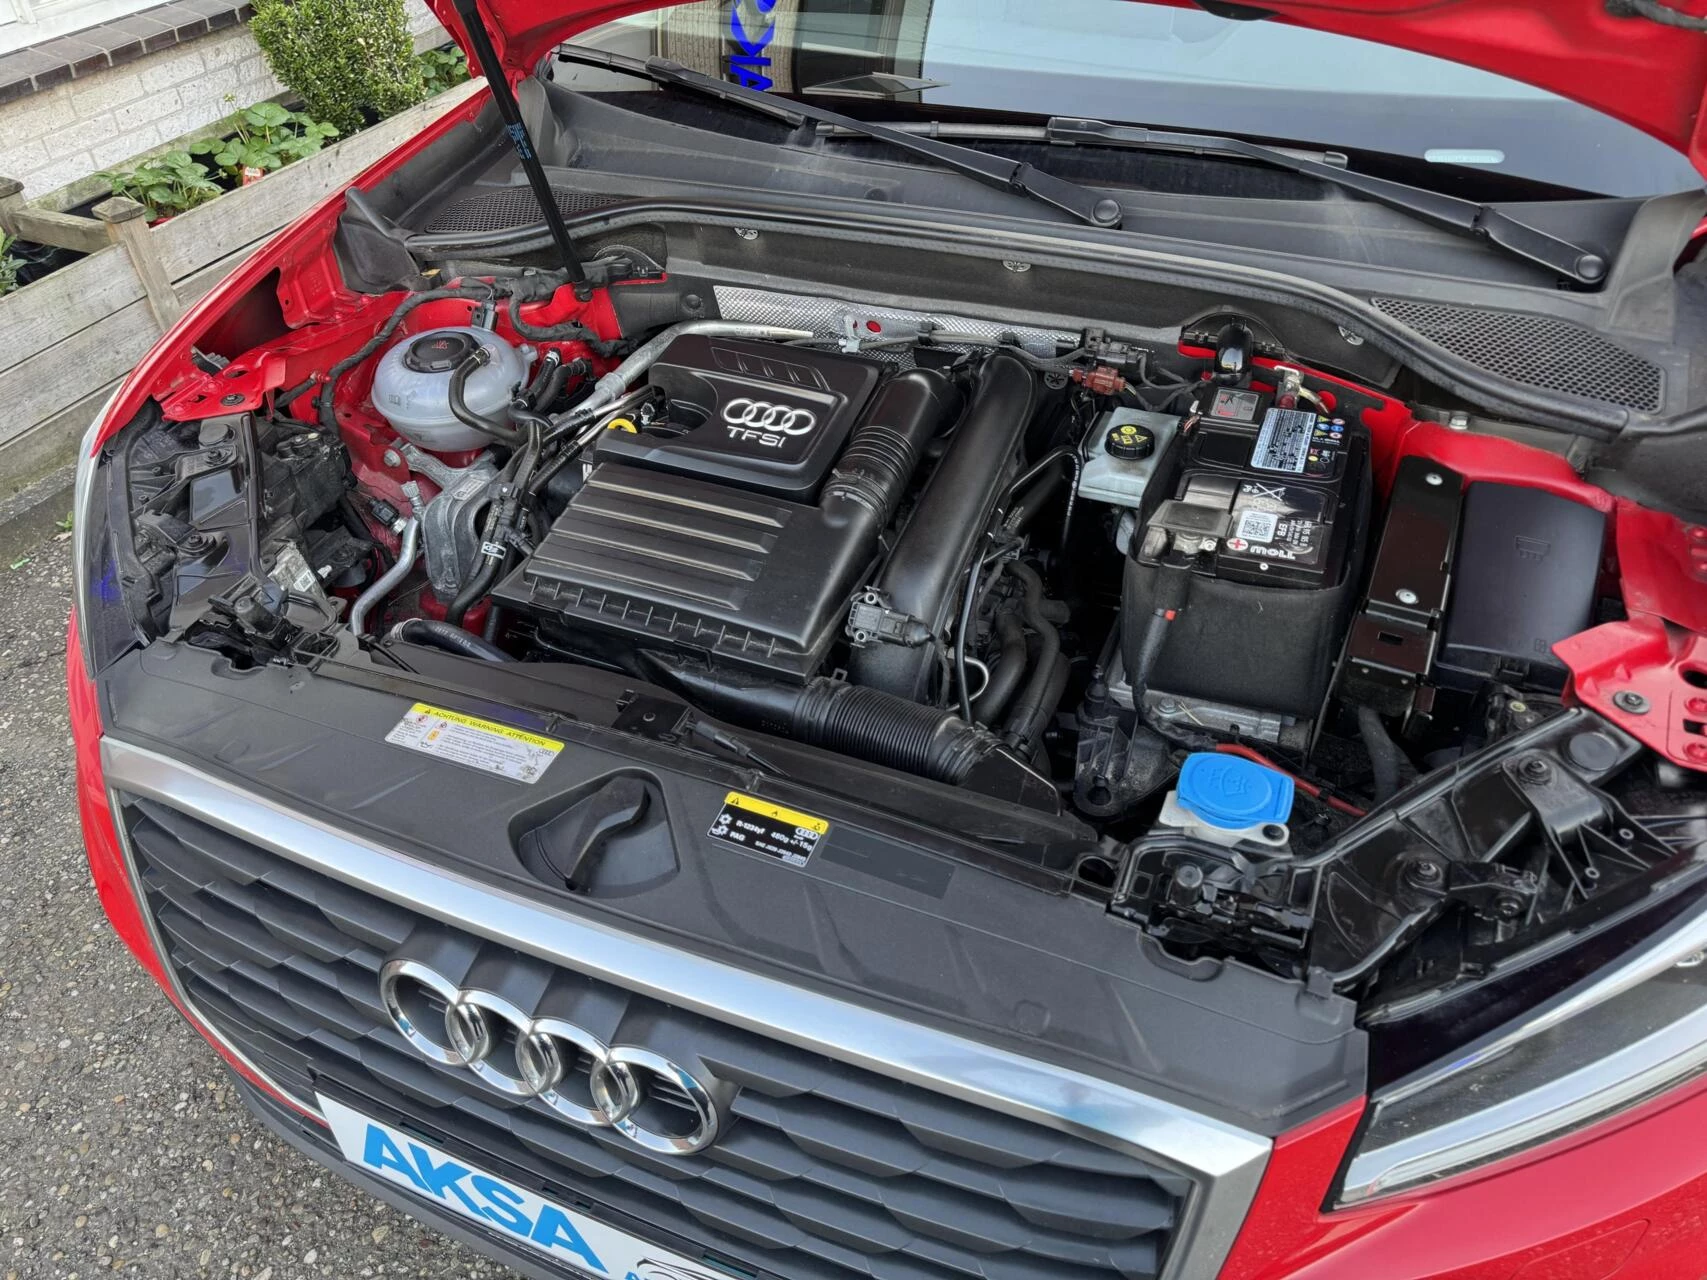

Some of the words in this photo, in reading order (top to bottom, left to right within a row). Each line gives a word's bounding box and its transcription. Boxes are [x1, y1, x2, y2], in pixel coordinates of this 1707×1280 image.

[727, 426, 787, 448] TFSI
[434, 711, 467, 725] ACHTUNG
[469, 719, 505, 735] WARNING
[506, 729, 547, 746] ATTENTION
[729, 830, 746, 842] PAG
[363, 1125, 607, 1272] AKSA
